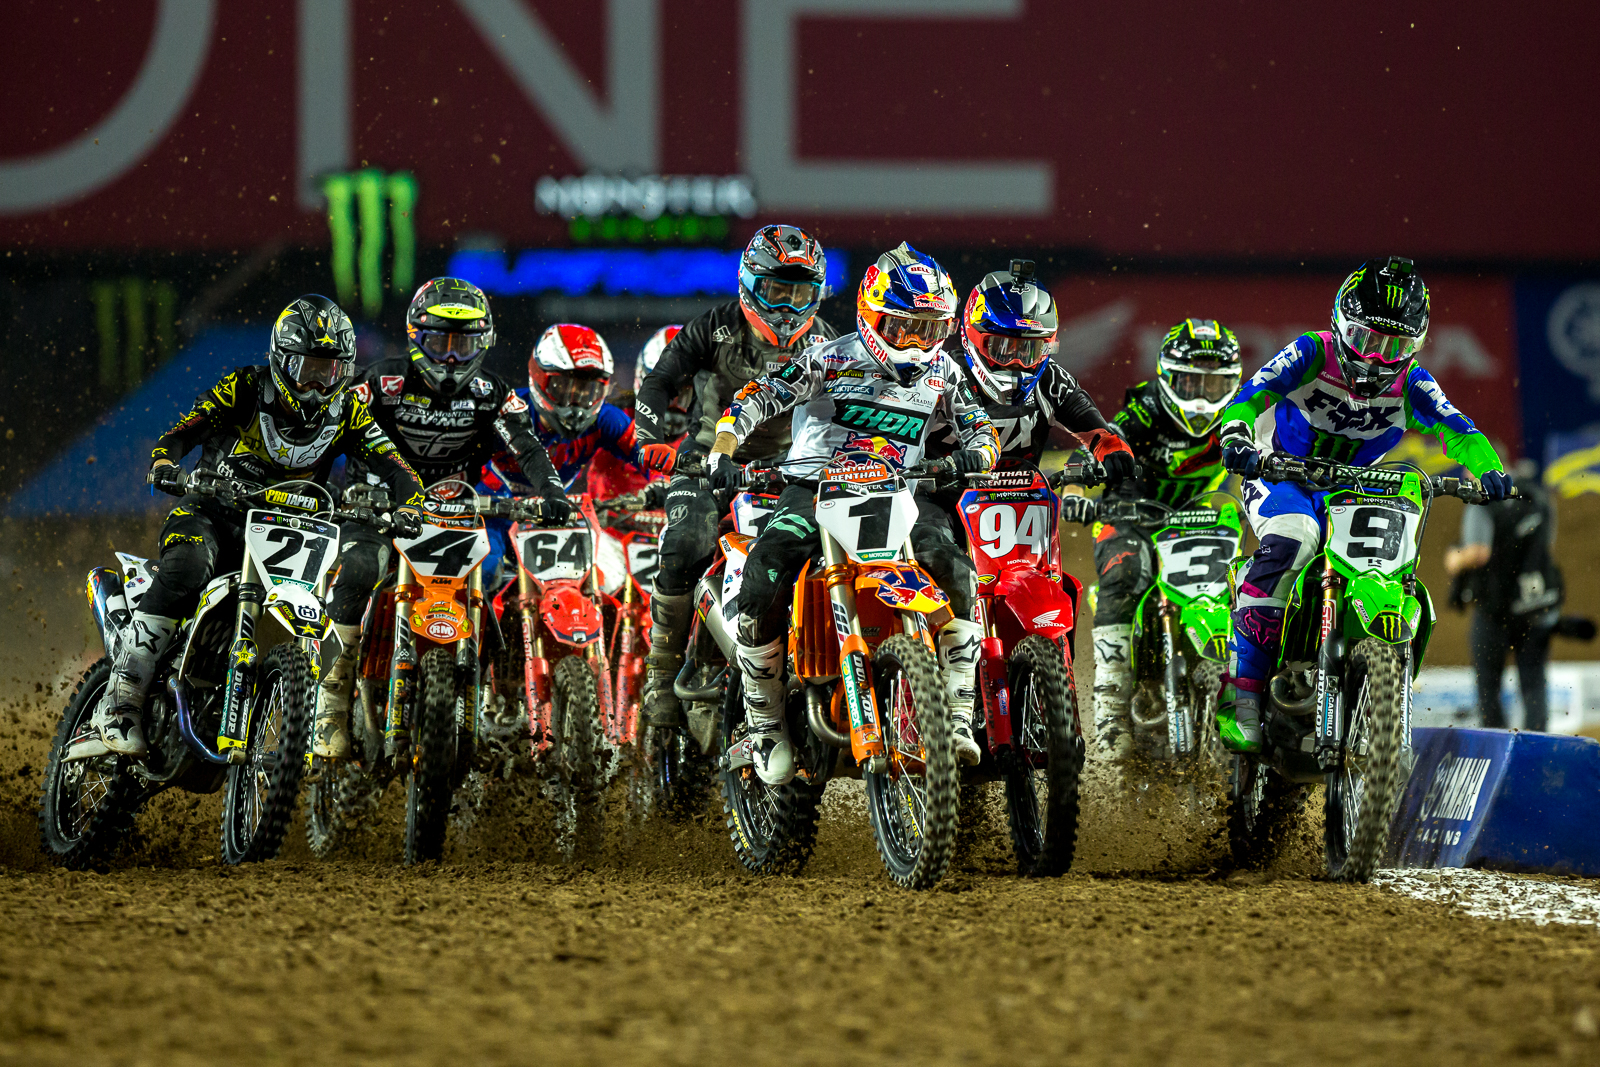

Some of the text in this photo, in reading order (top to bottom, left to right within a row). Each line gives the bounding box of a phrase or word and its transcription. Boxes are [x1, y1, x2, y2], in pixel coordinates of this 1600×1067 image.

[0, 0, 1053, 214] NE
[910, 266, 930, 274] BELL
[914, 300, 933, 309] Red
[933, 301, 951, 311] Bull
[1365, 315, 1421, 335] MONSTER
[866, 337, 889, 364] Bull
[834, 385, 871, 394] MOTOREX
[927, 379, 945, 389] BELL
[635, 398, 659, 426] NDA
[840, 403, 925, 441] THOR
[1303, 387, 1403, 433] FOX
[829, 470, 884, 481] RENTHAL
[1335, 467, 1403, 482] RENTHA
[1363, 497, 1397, 507] MONSTER
[282, 516, 315, 529] MTER
[848, 496, 893, 551] 1
[979, 503, 1049, 560] 94
[1346, 507, 1407, 561] 9
[262, 528, 330, 584] 21
[404, 530, 479, 578] 4
[523, 532, 591, 575] 64
[868, 551, 894, 560] MOTOREX
[1006, 558, 1031, 566] HONDA
[1167, 538, 1236, 588] 3
[432, 624, 452, 635] RM
[1033, 622, 1067, 630] HONDA
[844, 675, 862, 726] MOTOREX
[1316, 668, 1326, 738] DUNLOP
